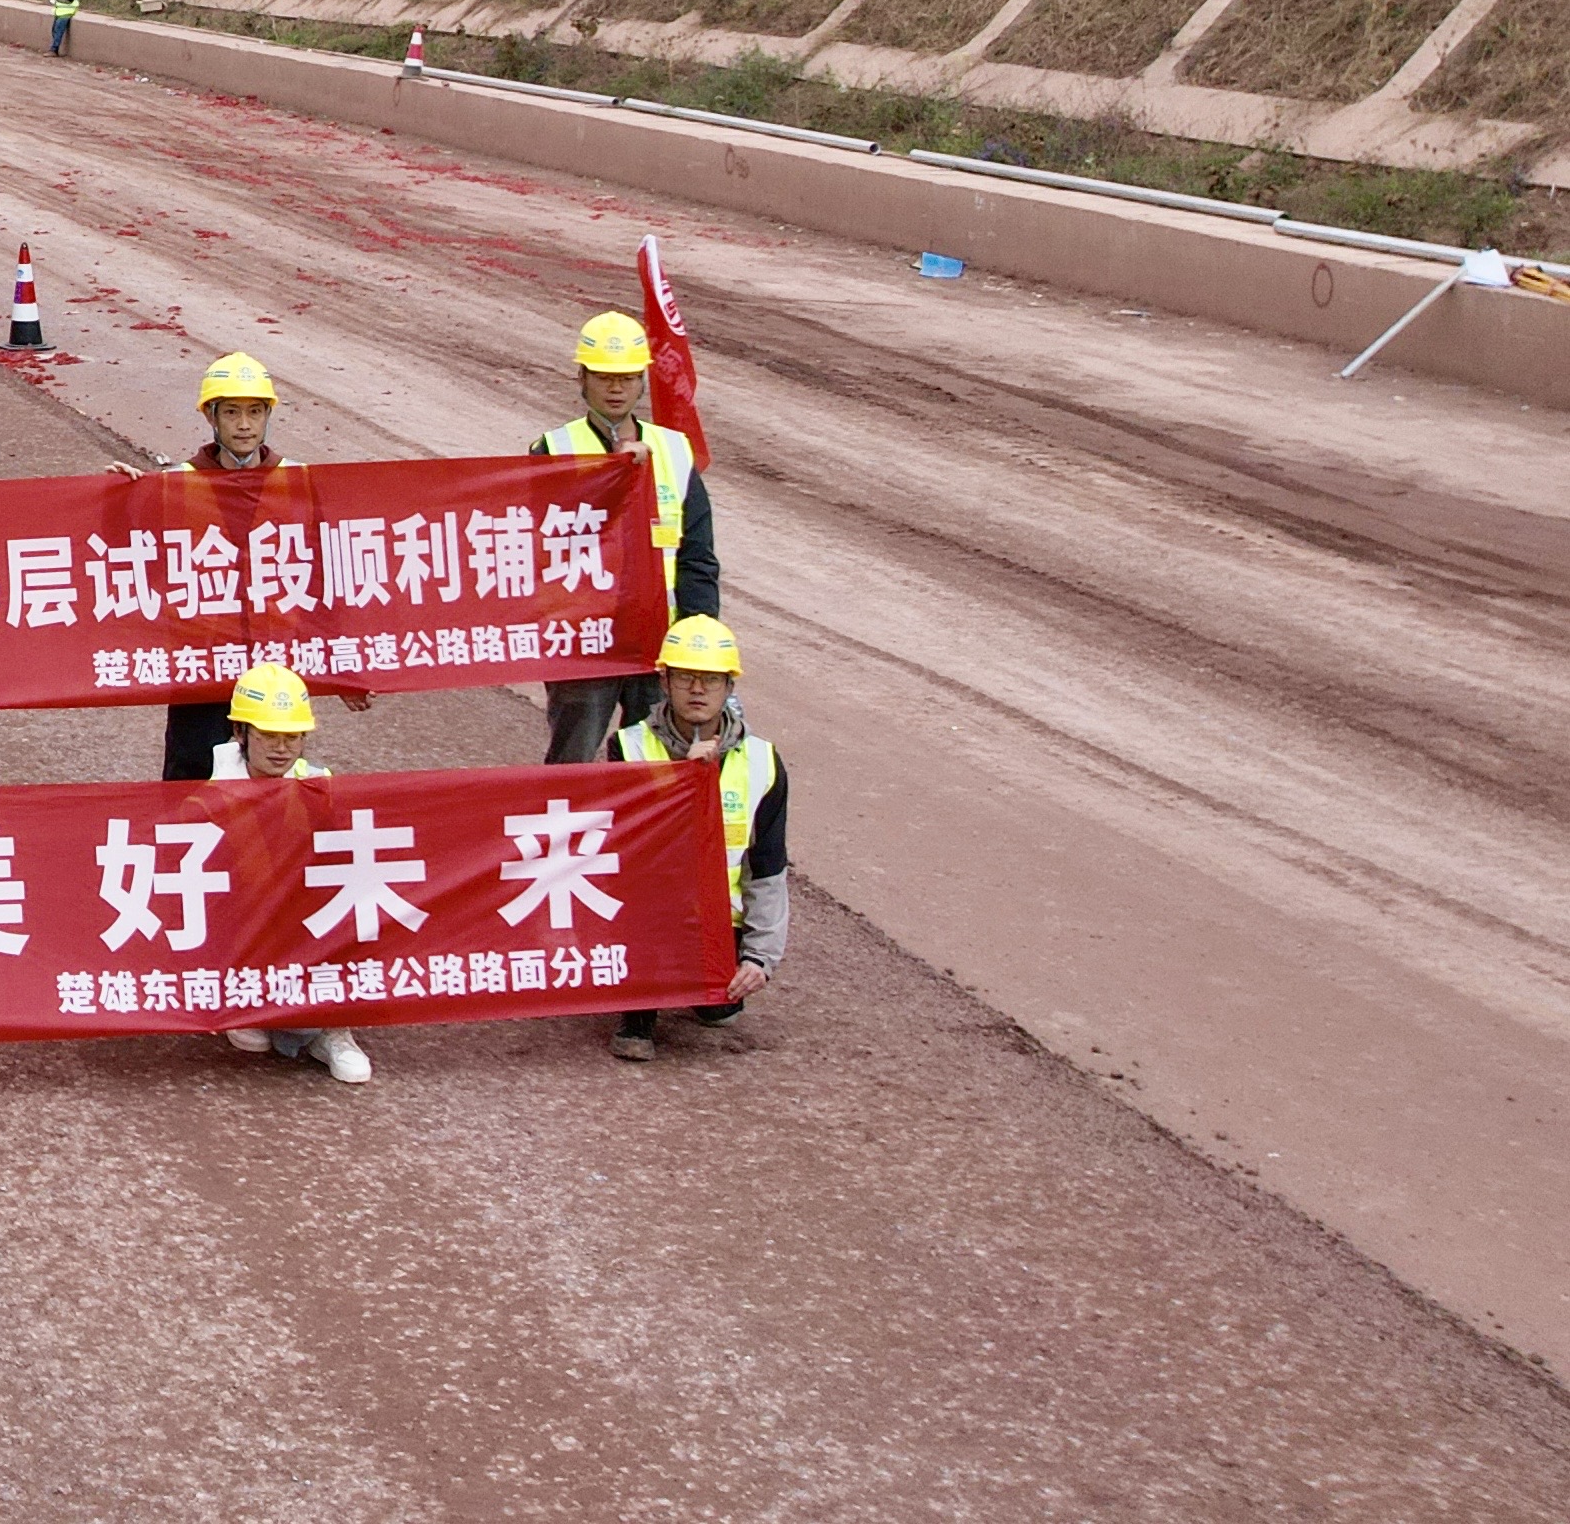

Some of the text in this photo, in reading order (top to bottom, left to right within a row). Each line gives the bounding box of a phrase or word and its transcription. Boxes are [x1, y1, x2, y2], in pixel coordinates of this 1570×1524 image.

[93, 617, 614, 688] 楚雄东南绕城高速公路路面分部
[57, 944, 628, 1014] 楚雄东南绕城高速公路路面分部
